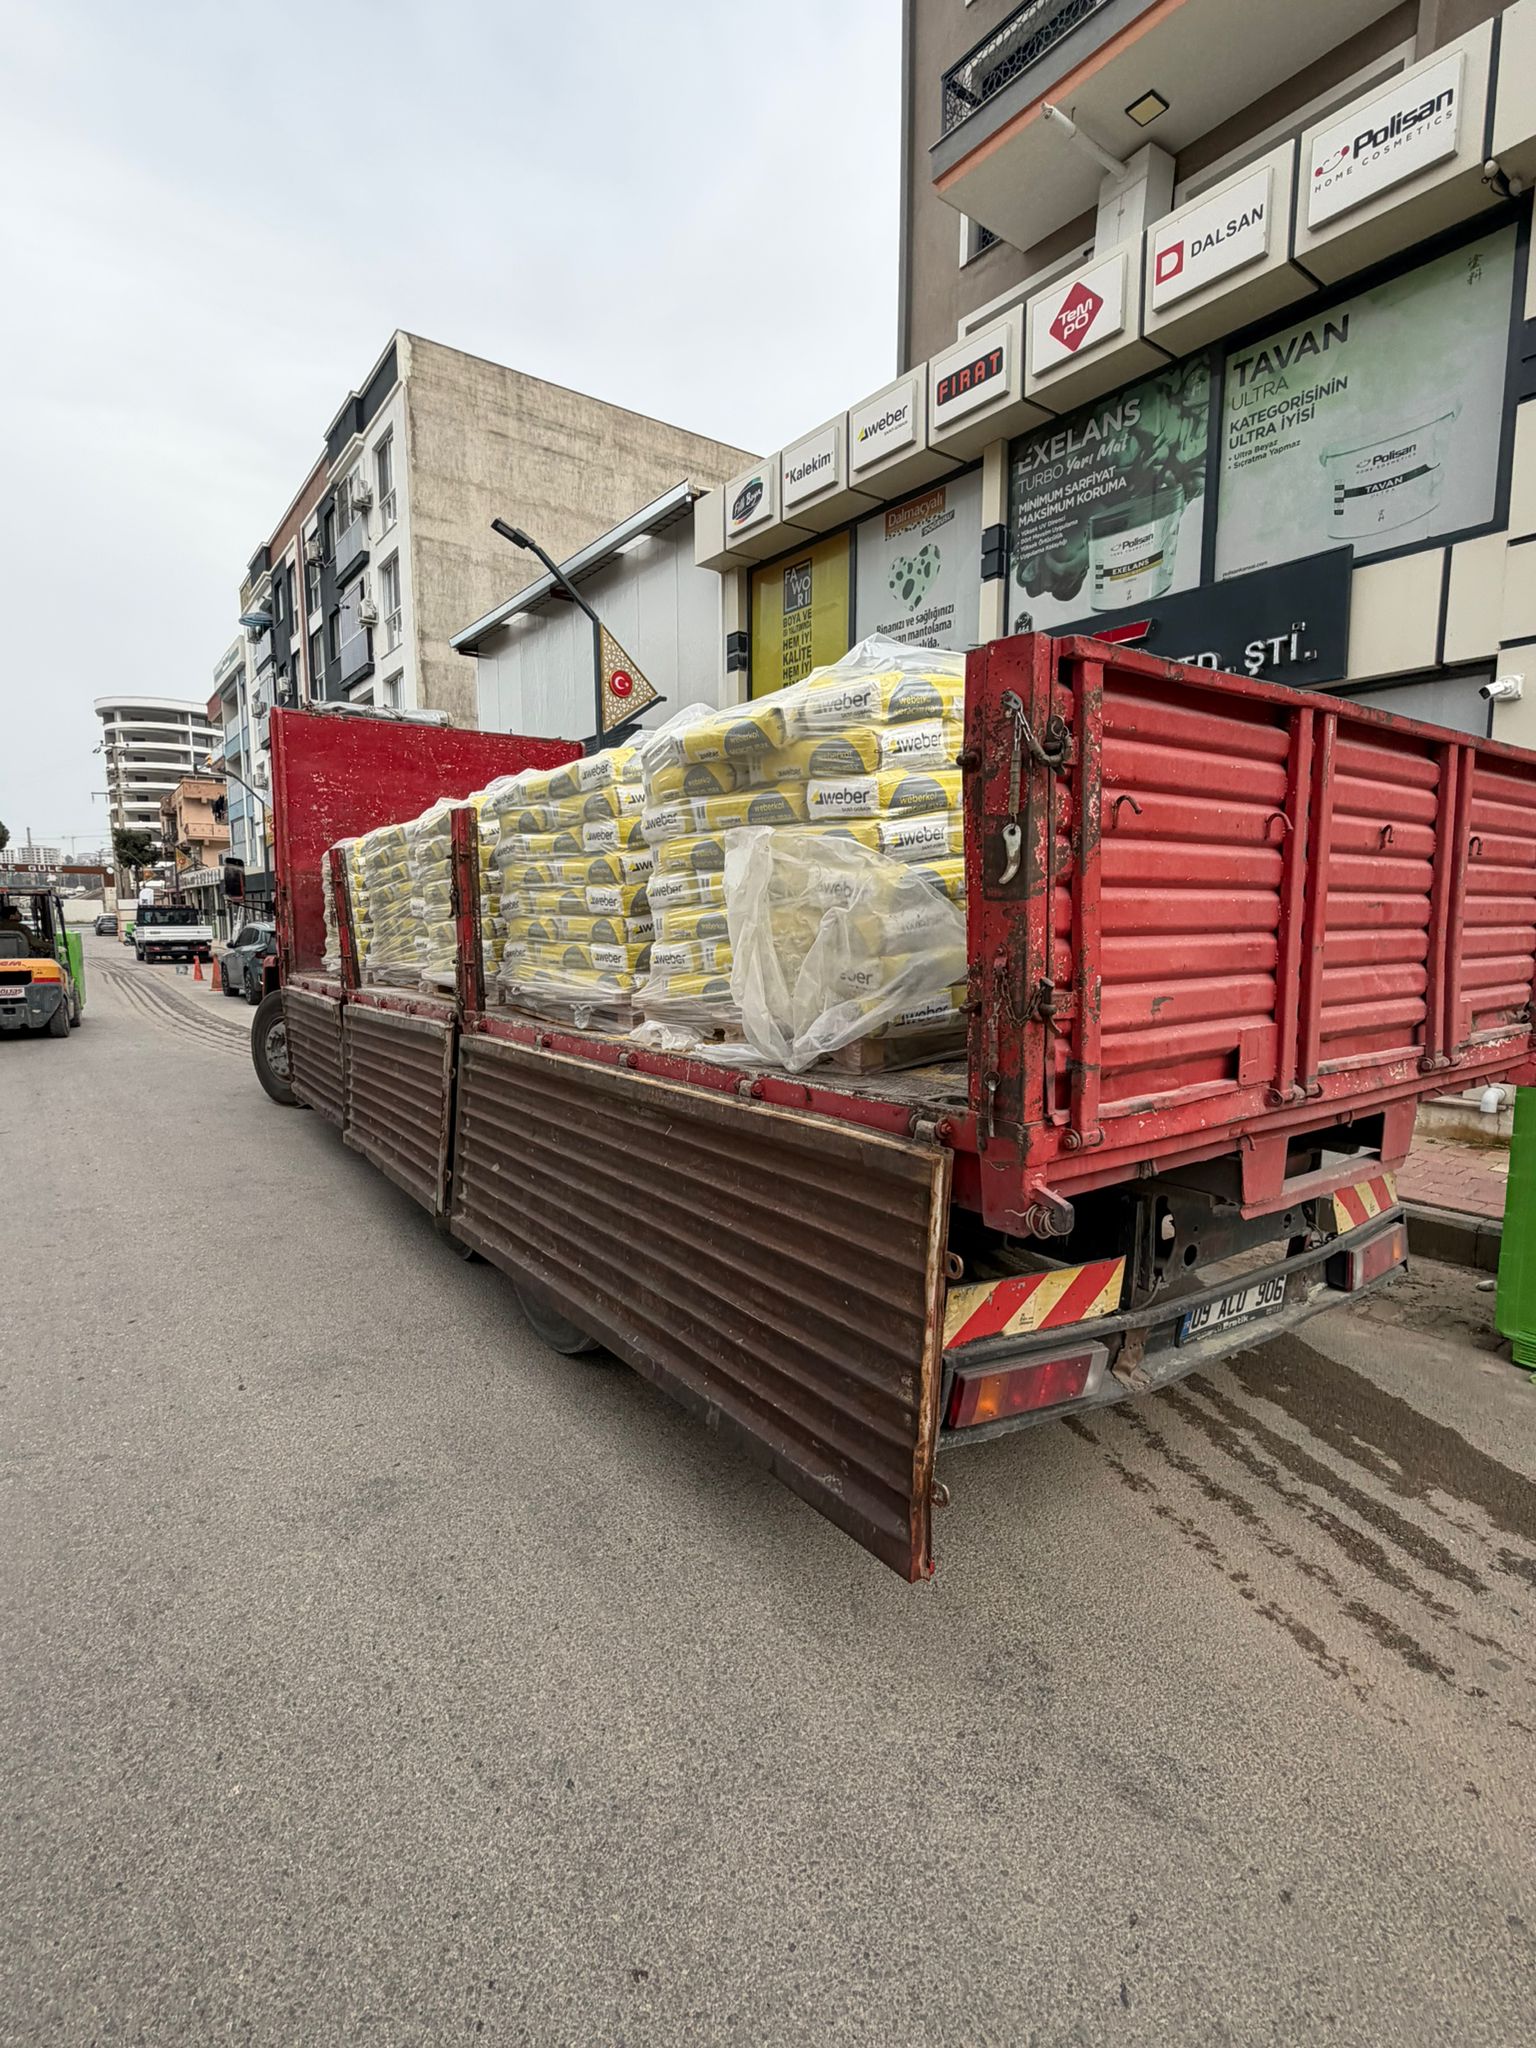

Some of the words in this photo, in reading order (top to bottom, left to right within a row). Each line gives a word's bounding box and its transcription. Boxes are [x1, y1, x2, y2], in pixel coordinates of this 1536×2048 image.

[1353, 88, 1454, 160] Polisan
[1314, 166, 1353, 193] HOME
[1362, 110, 1453, 166] COSMETICS
[1191, 204, 1263, 258] DALSAN
[1233, 314, 1349, 387] TAVAN
[939, 351, 1000, 403] FIRAT
[1231, 376, 1289, 411] ULTRA
[1230, 376, 1348, 434] KATEGORİSİNİN
[867, 404, 908, 437] weber
[1229, 422, 1277, 449] ULTRA
[1281, 403, 1315, 430] İYİSİ
[1018, 399, 1141, 476] EXELANS
[1233, 453, 1267, 469] Sıçratma
[1269, 440, 1301, 456] Yapmaz
[1234, 449, 1253, 461] Ultra
[1254, 440, 1278, 453] Beyaz
[1372, 444, 1417, 466] Polisan
[789, 452, 831, 485] Kalekim
[1019, 464, 1063, 494] TURBO
[1066, 454, 1093, 475] Yarı
[1097, 433, 1129, 461] Mat
[1019, 488, 1063, 515] MİNİMUM
[1065, 465, 1116, 496] SARFİYAT
[1365, 476, 1404, 493] TAVAN
[888, 493, 944, 527] Dalmaçyalı
[1018, 496, 1075, 528] MAKSİMUM
[1076, 477, 1127, 506] KORUMA
[1122, 533, 1154, 550] Polisan
[1112, 559, 1150, 575] EXELANS
[783, 612, 800, 628] BOYA
[802, 608, 812, 620] VE
[906, 617, 915, 627] ve
[915, 604, 955, 625] sağlığınızı
[907, 620, 952, 641] mantolama
[783, 635, 799, 651] HEM
[1244, 621, 1316, 676] ŞTİ.
[783, 645, 812, 666] KALİTE
[783, 664, 799, 680] HEM
[822, 692, 871, 715] weber
[900, 732, 942, 753] weber
[586, 762, 610, 780] weber
[822, 787, 871, 805] weber
[650, 812, 678, 829] weber
[591, 830, 614, 841] weber
[902, 826, 945, 845] weber
[593, 896, 618, 906] weber
[654, 883, 683, 897] weber
[598, 953, 622, 964] weber
[658, 953, 686, 965] weber
[908, 1004, 949, 1025] weber
[1191, 1304, 1212, 1329] 09
[1255, 1276, 1285, 1307] 906
